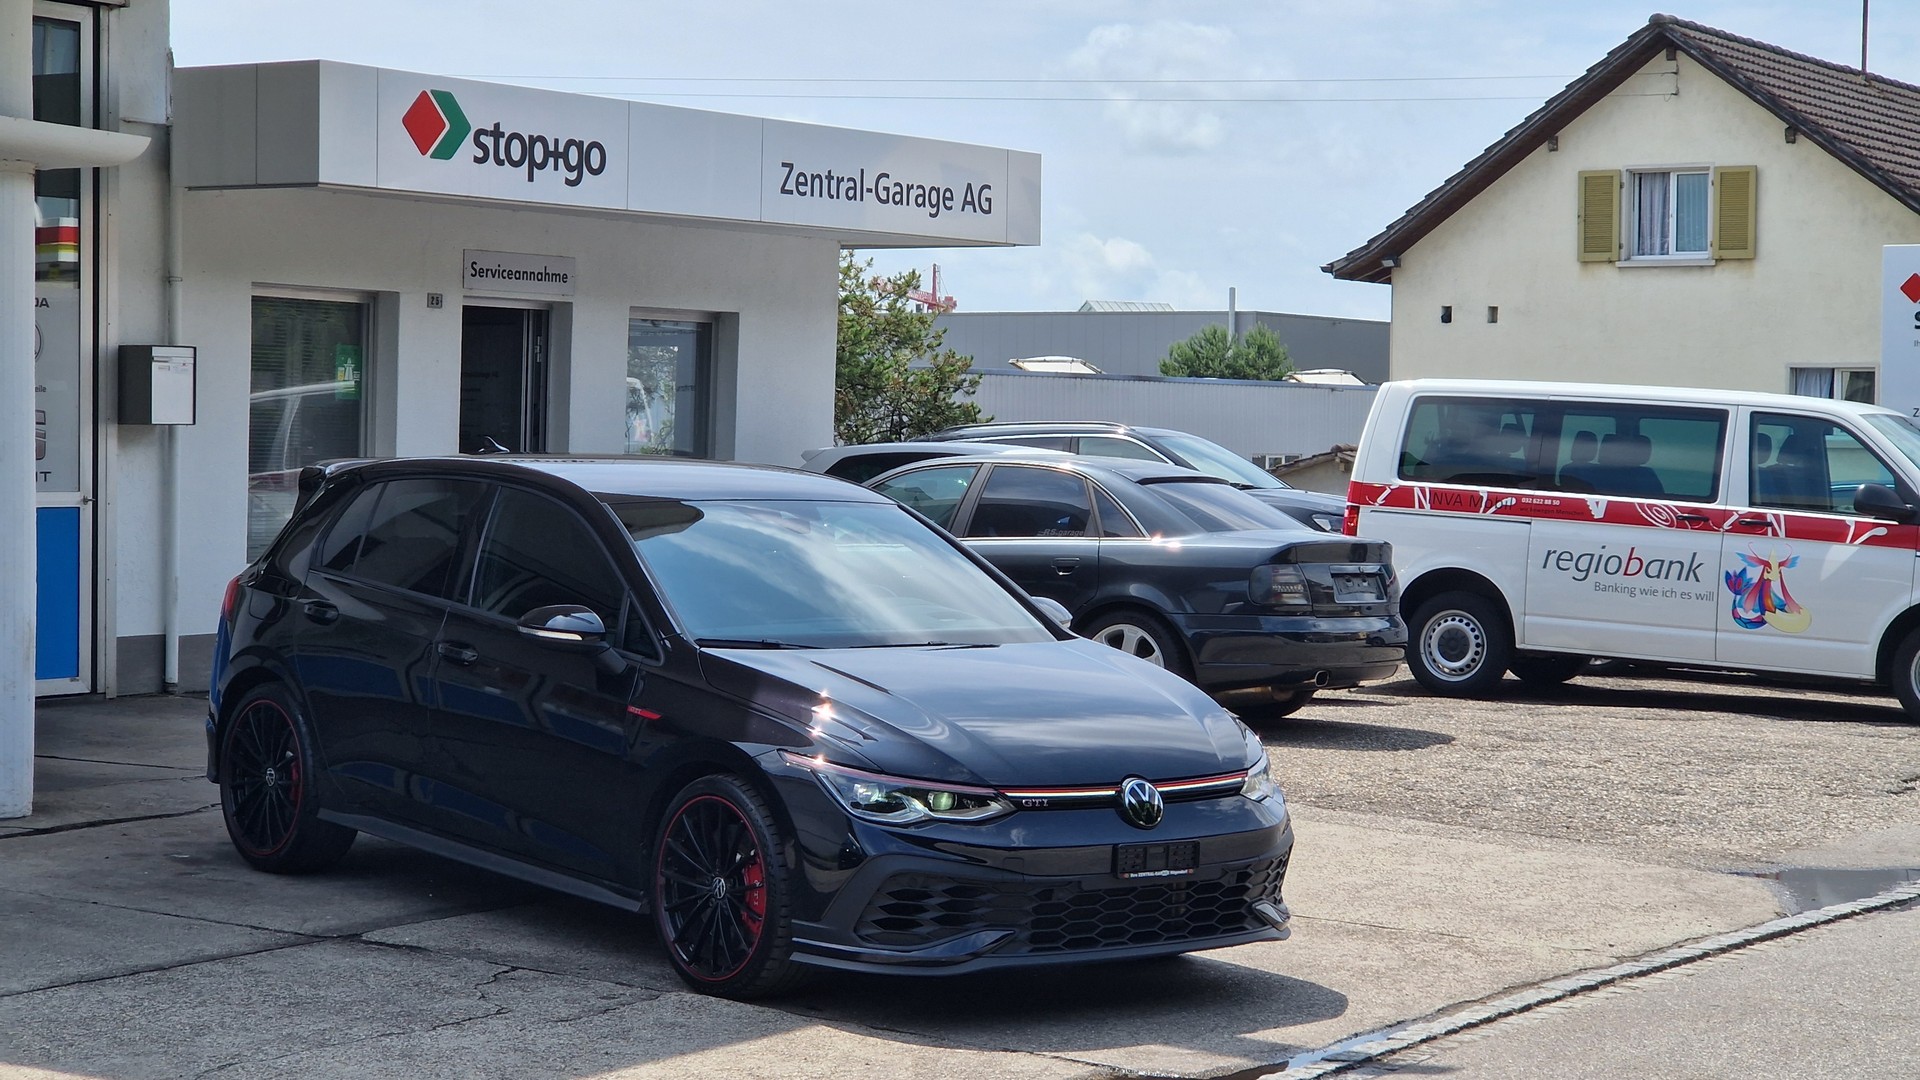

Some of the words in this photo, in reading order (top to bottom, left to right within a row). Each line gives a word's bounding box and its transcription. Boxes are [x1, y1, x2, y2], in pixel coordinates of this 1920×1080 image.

[473, 121, 607, 187] stop+go
[780, 161, 954, 218] Zentral-Garage
[961, 182, 992, 215] AG
[470, 260, 568, 283] Serviceannahme
[1542, 545, 1704, 582] regiobank
[1594, 581, 1637, 597] Banking
[1639, 585, 1659, 597] wie
[1661, 585, 1677, 599] ich
[1680, 589, 1692, 600] es
[1695, 590, 1715, 602] will
[1022, 798, 1049, 807] GTI
